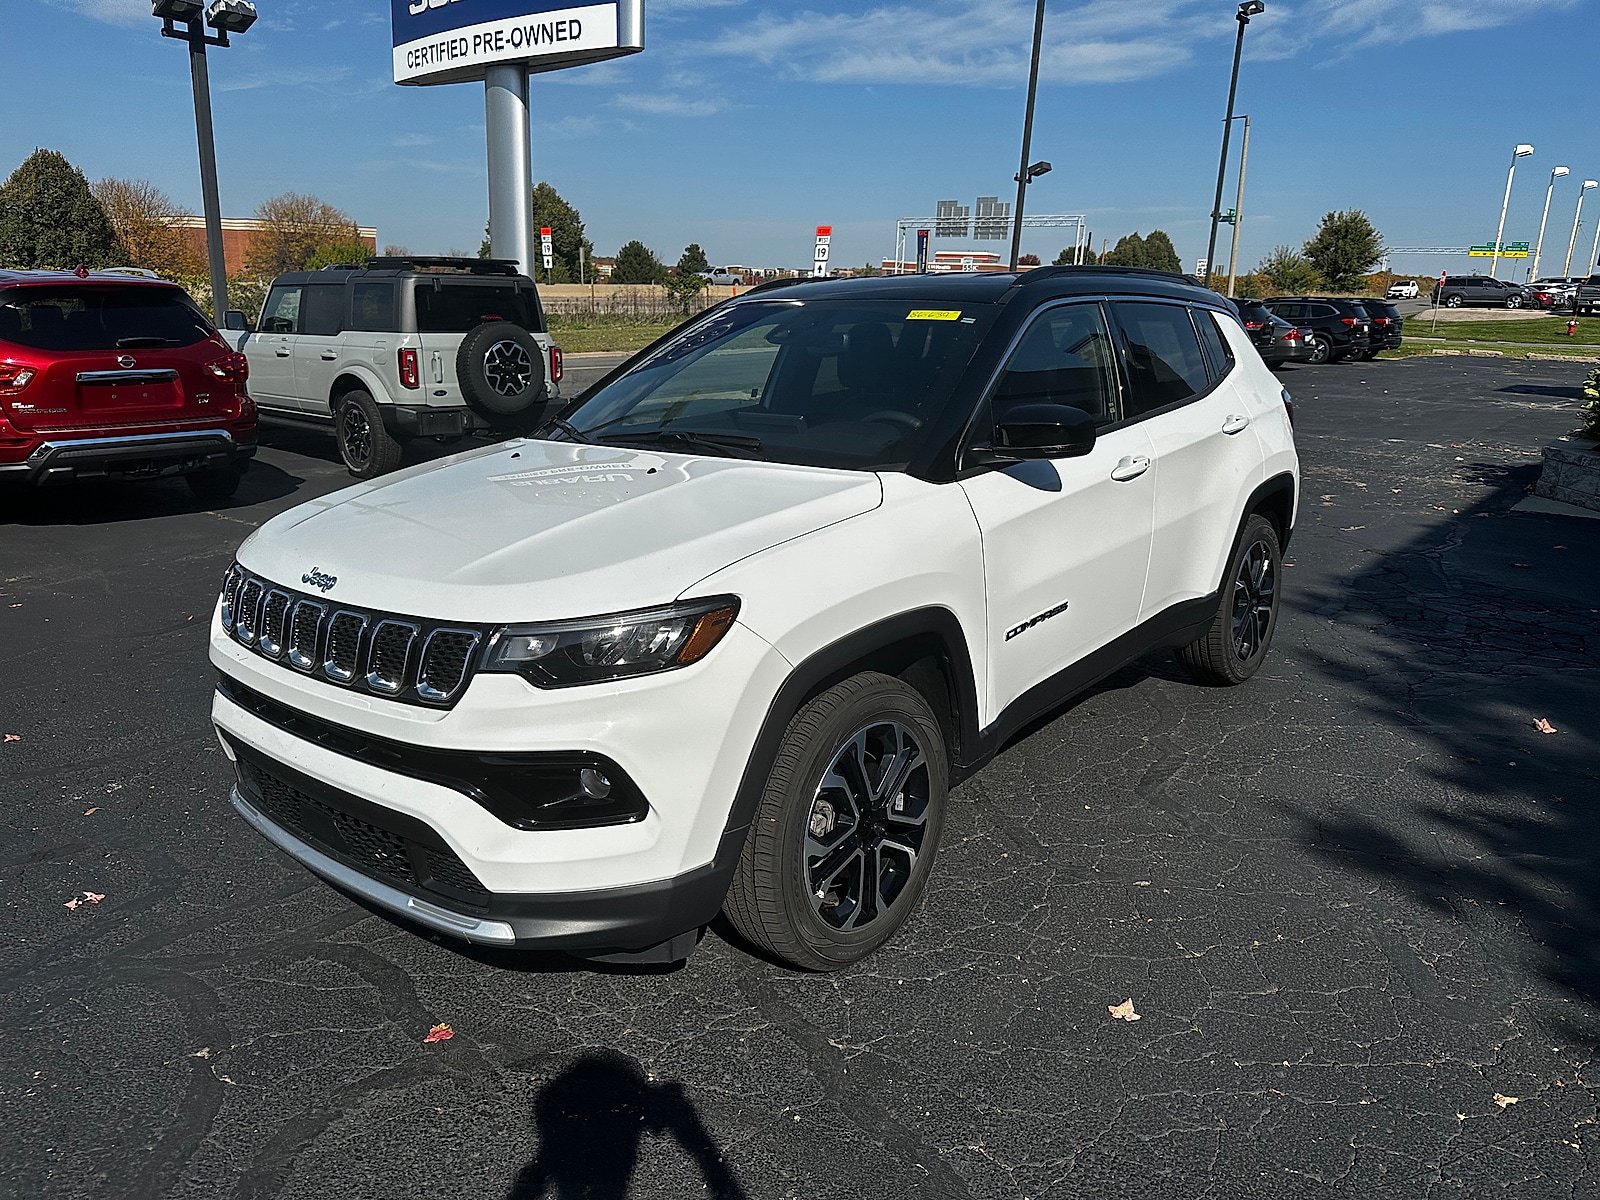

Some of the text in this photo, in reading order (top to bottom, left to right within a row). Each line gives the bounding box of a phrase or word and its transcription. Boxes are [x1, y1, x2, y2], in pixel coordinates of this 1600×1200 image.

[407, 19, 582, 69] CERTIFIED PRE-OWNED
[817, 247, 827, 258] 19
[302, 566, 338, 593] Jeep
[1005, 601, 1069, 642] COMPASS
